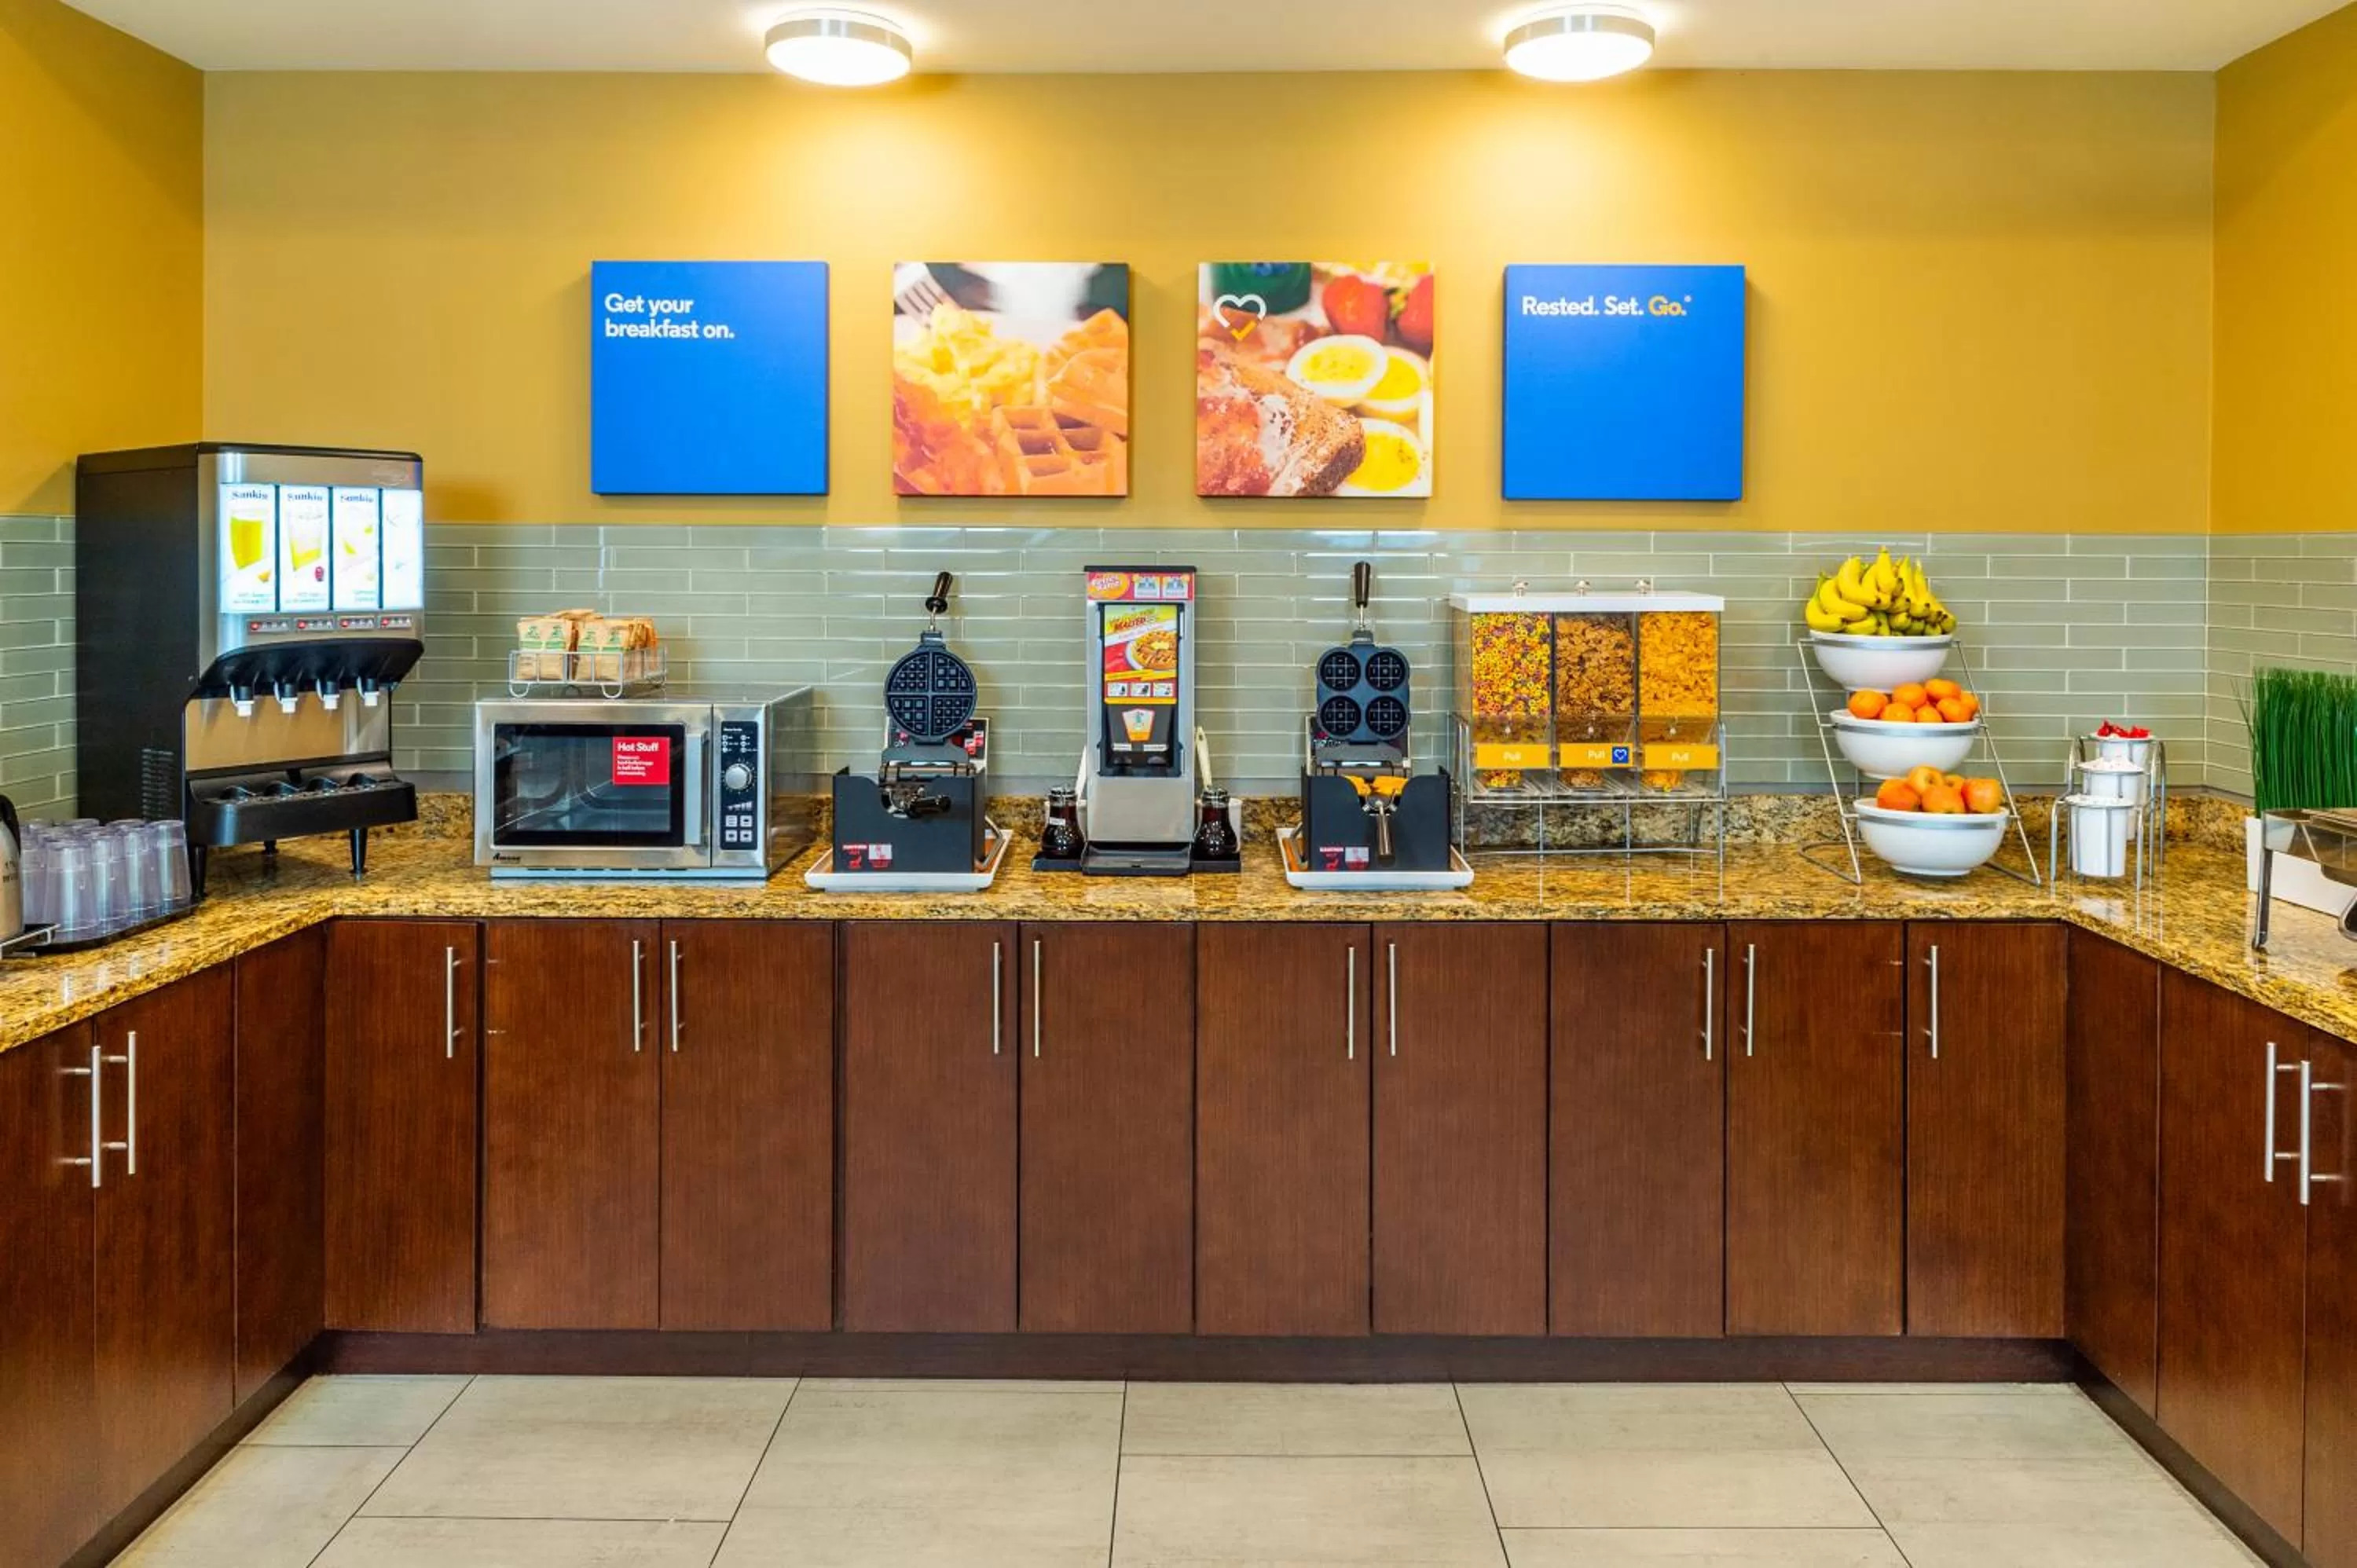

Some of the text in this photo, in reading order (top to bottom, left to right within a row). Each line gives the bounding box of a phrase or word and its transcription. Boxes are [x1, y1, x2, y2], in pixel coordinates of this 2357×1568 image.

[604, 293, 694, 317] Get your
[1522, 295, 1600, 316] Rested.
[1604, 295, 1644, 316] Set.
[604, 318, 735, 339] breakfast on.
[618, 742, 659, 752] Hot Stuff
[1503, 751, 1522, 761] Pull
[1587, 750, 1605, 760] Pull
[1671, 752, 1690, 761] Pull
